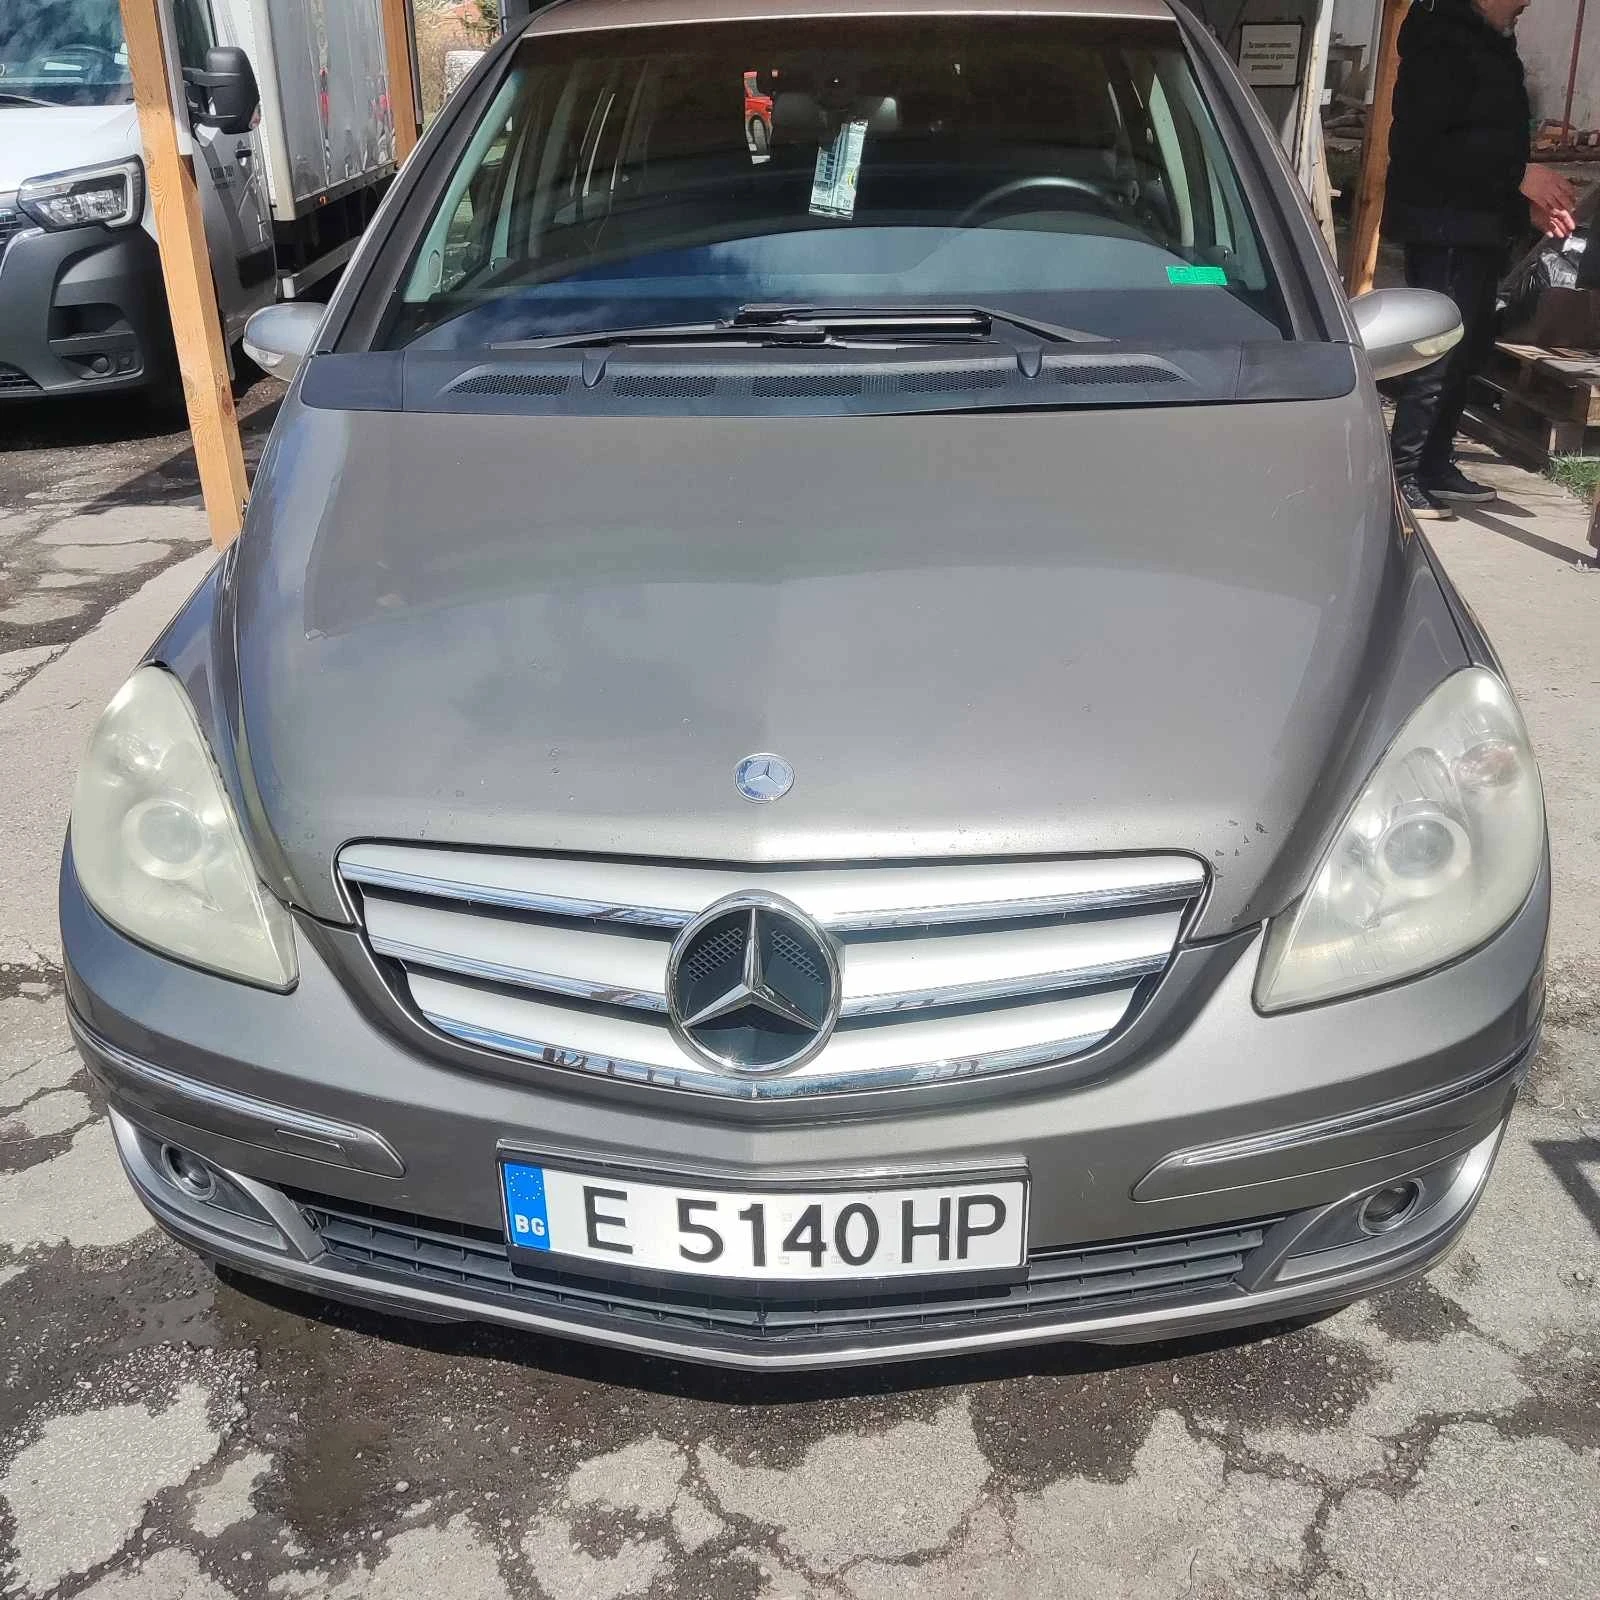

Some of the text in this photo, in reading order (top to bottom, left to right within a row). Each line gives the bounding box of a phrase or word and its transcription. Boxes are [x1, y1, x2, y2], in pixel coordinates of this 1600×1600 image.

[514, 1214, 546, 1236] BG
[583, 1185, 1007, 1268] E 5140 HP
